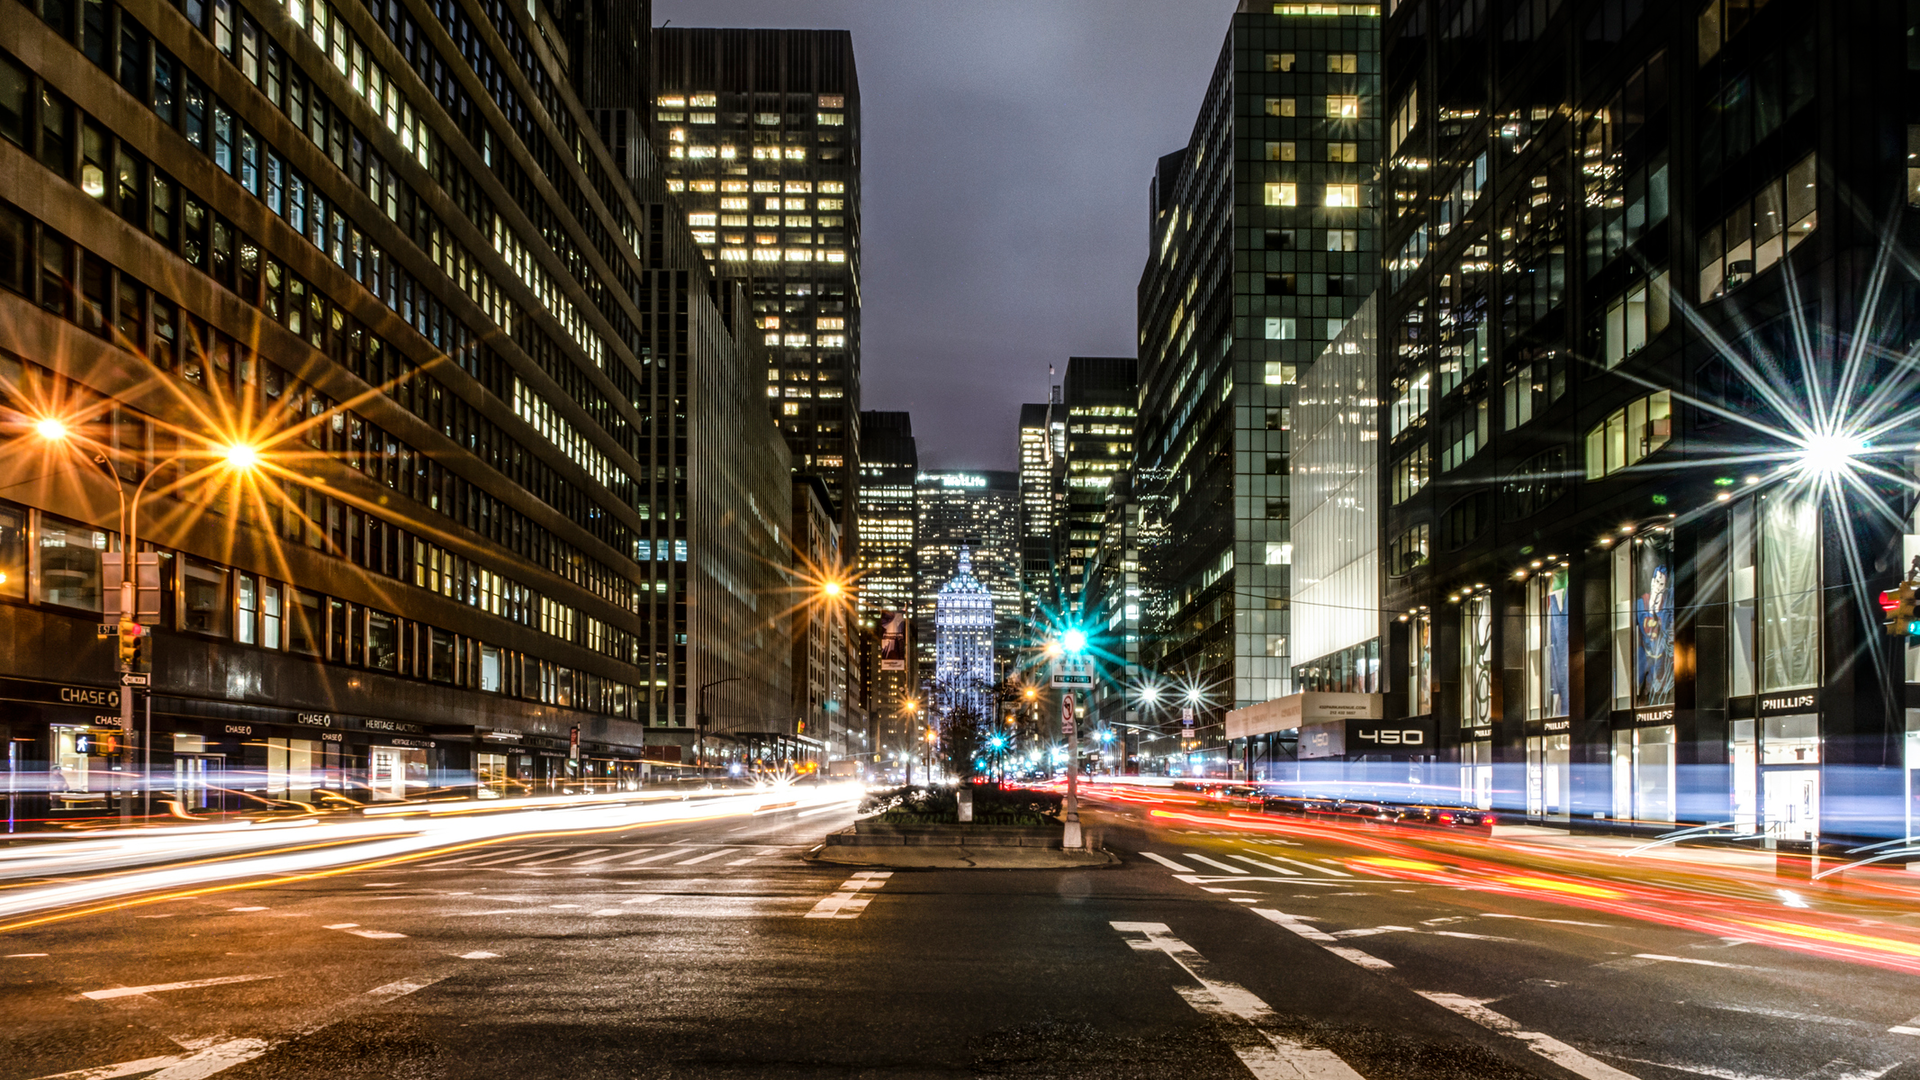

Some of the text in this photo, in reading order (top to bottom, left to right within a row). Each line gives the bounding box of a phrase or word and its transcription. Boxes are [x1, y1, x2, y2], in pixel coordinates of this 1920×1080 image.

[942, 474, 986, 487] MetLife
[61, 687, 106, 705] CHASE
[1763, 695, 1814, 710] PHILLIPS
[95, 715, 122, 726] CHASE
[298, 713, 323, 725] CHASE
[1636, 710, 1673, 722] PHILLIPS
[225, 725, 245, 734] CHASE
[366, 719, 424, 734] HERITAGE AUCTIONS
[322, 733, 338, 741] CHASE
[391, 738, 410, 746] HERITAGE
[1311, 732, 1329, 746] 450
[1359, 729, 1424, 745] 450
